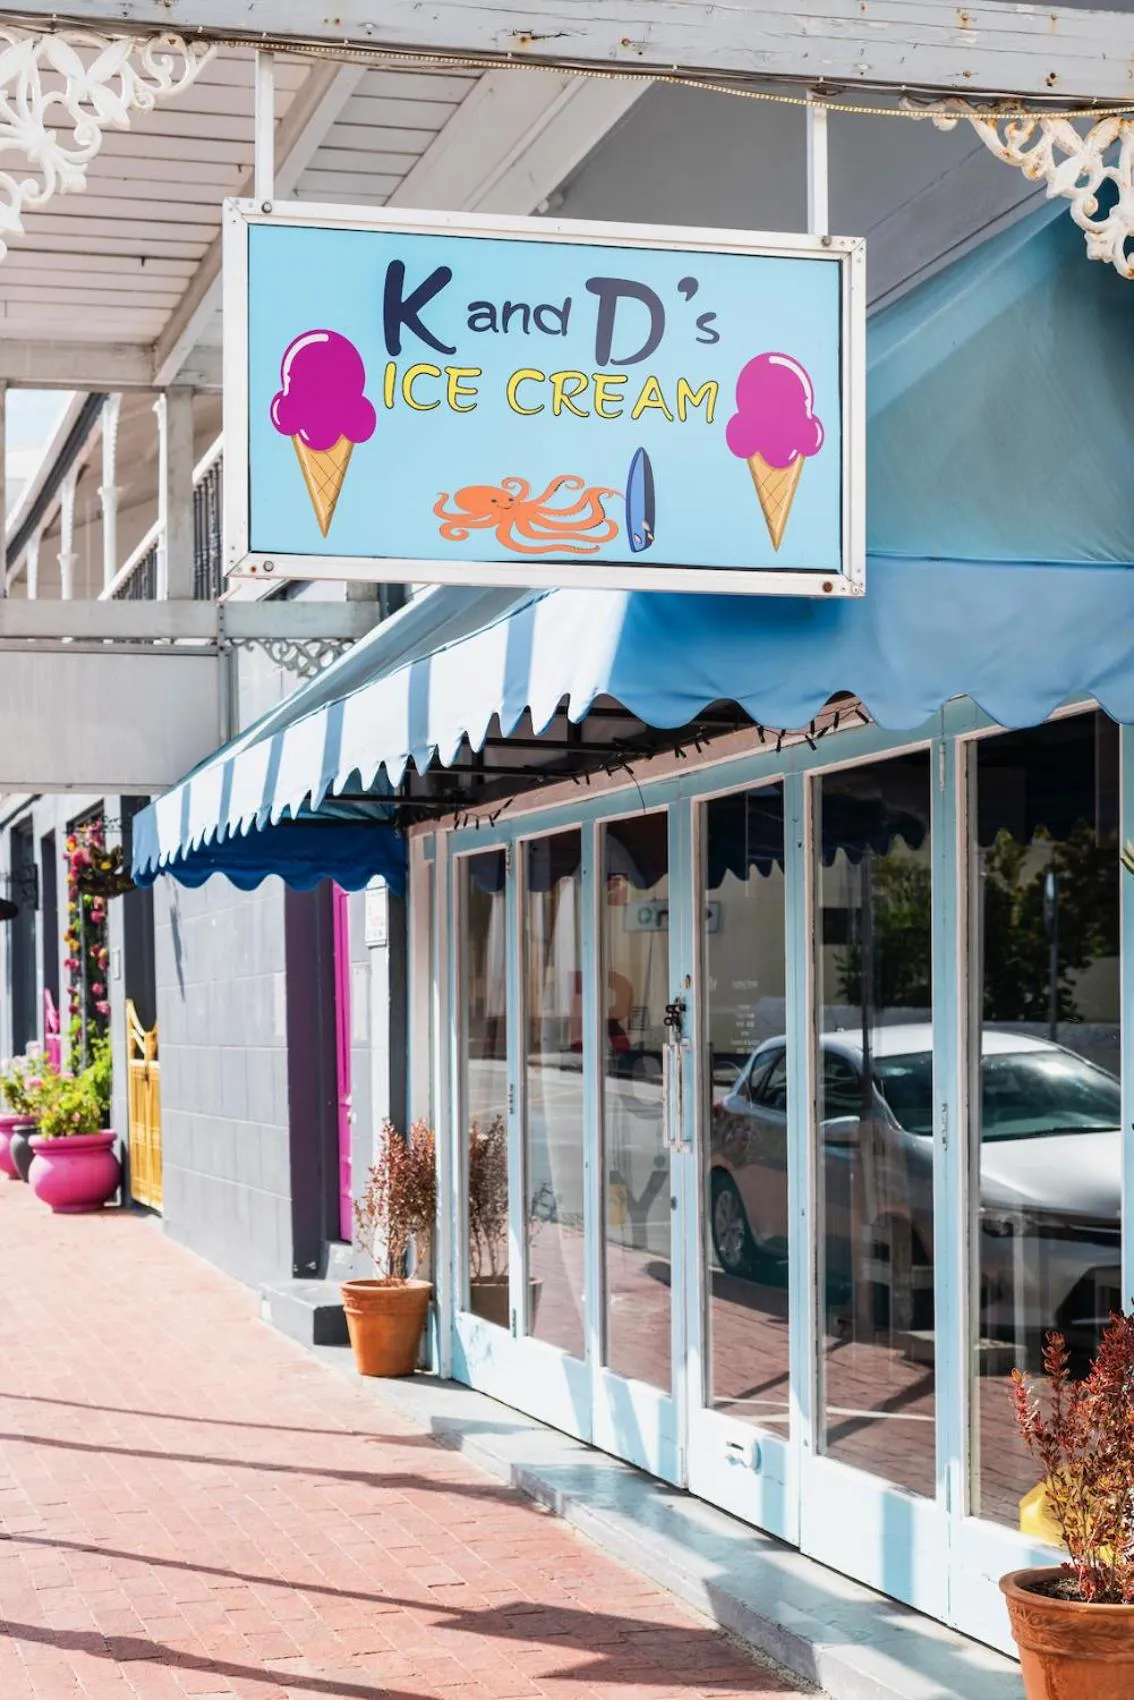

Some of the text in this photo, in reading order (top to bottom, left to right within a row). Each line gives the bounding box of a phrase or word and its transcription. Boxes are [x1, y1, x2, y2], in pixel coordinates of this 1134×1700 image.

[382, 258, 720, 367] K and D's
[383, 360, 719, 425] ICE CREAM
